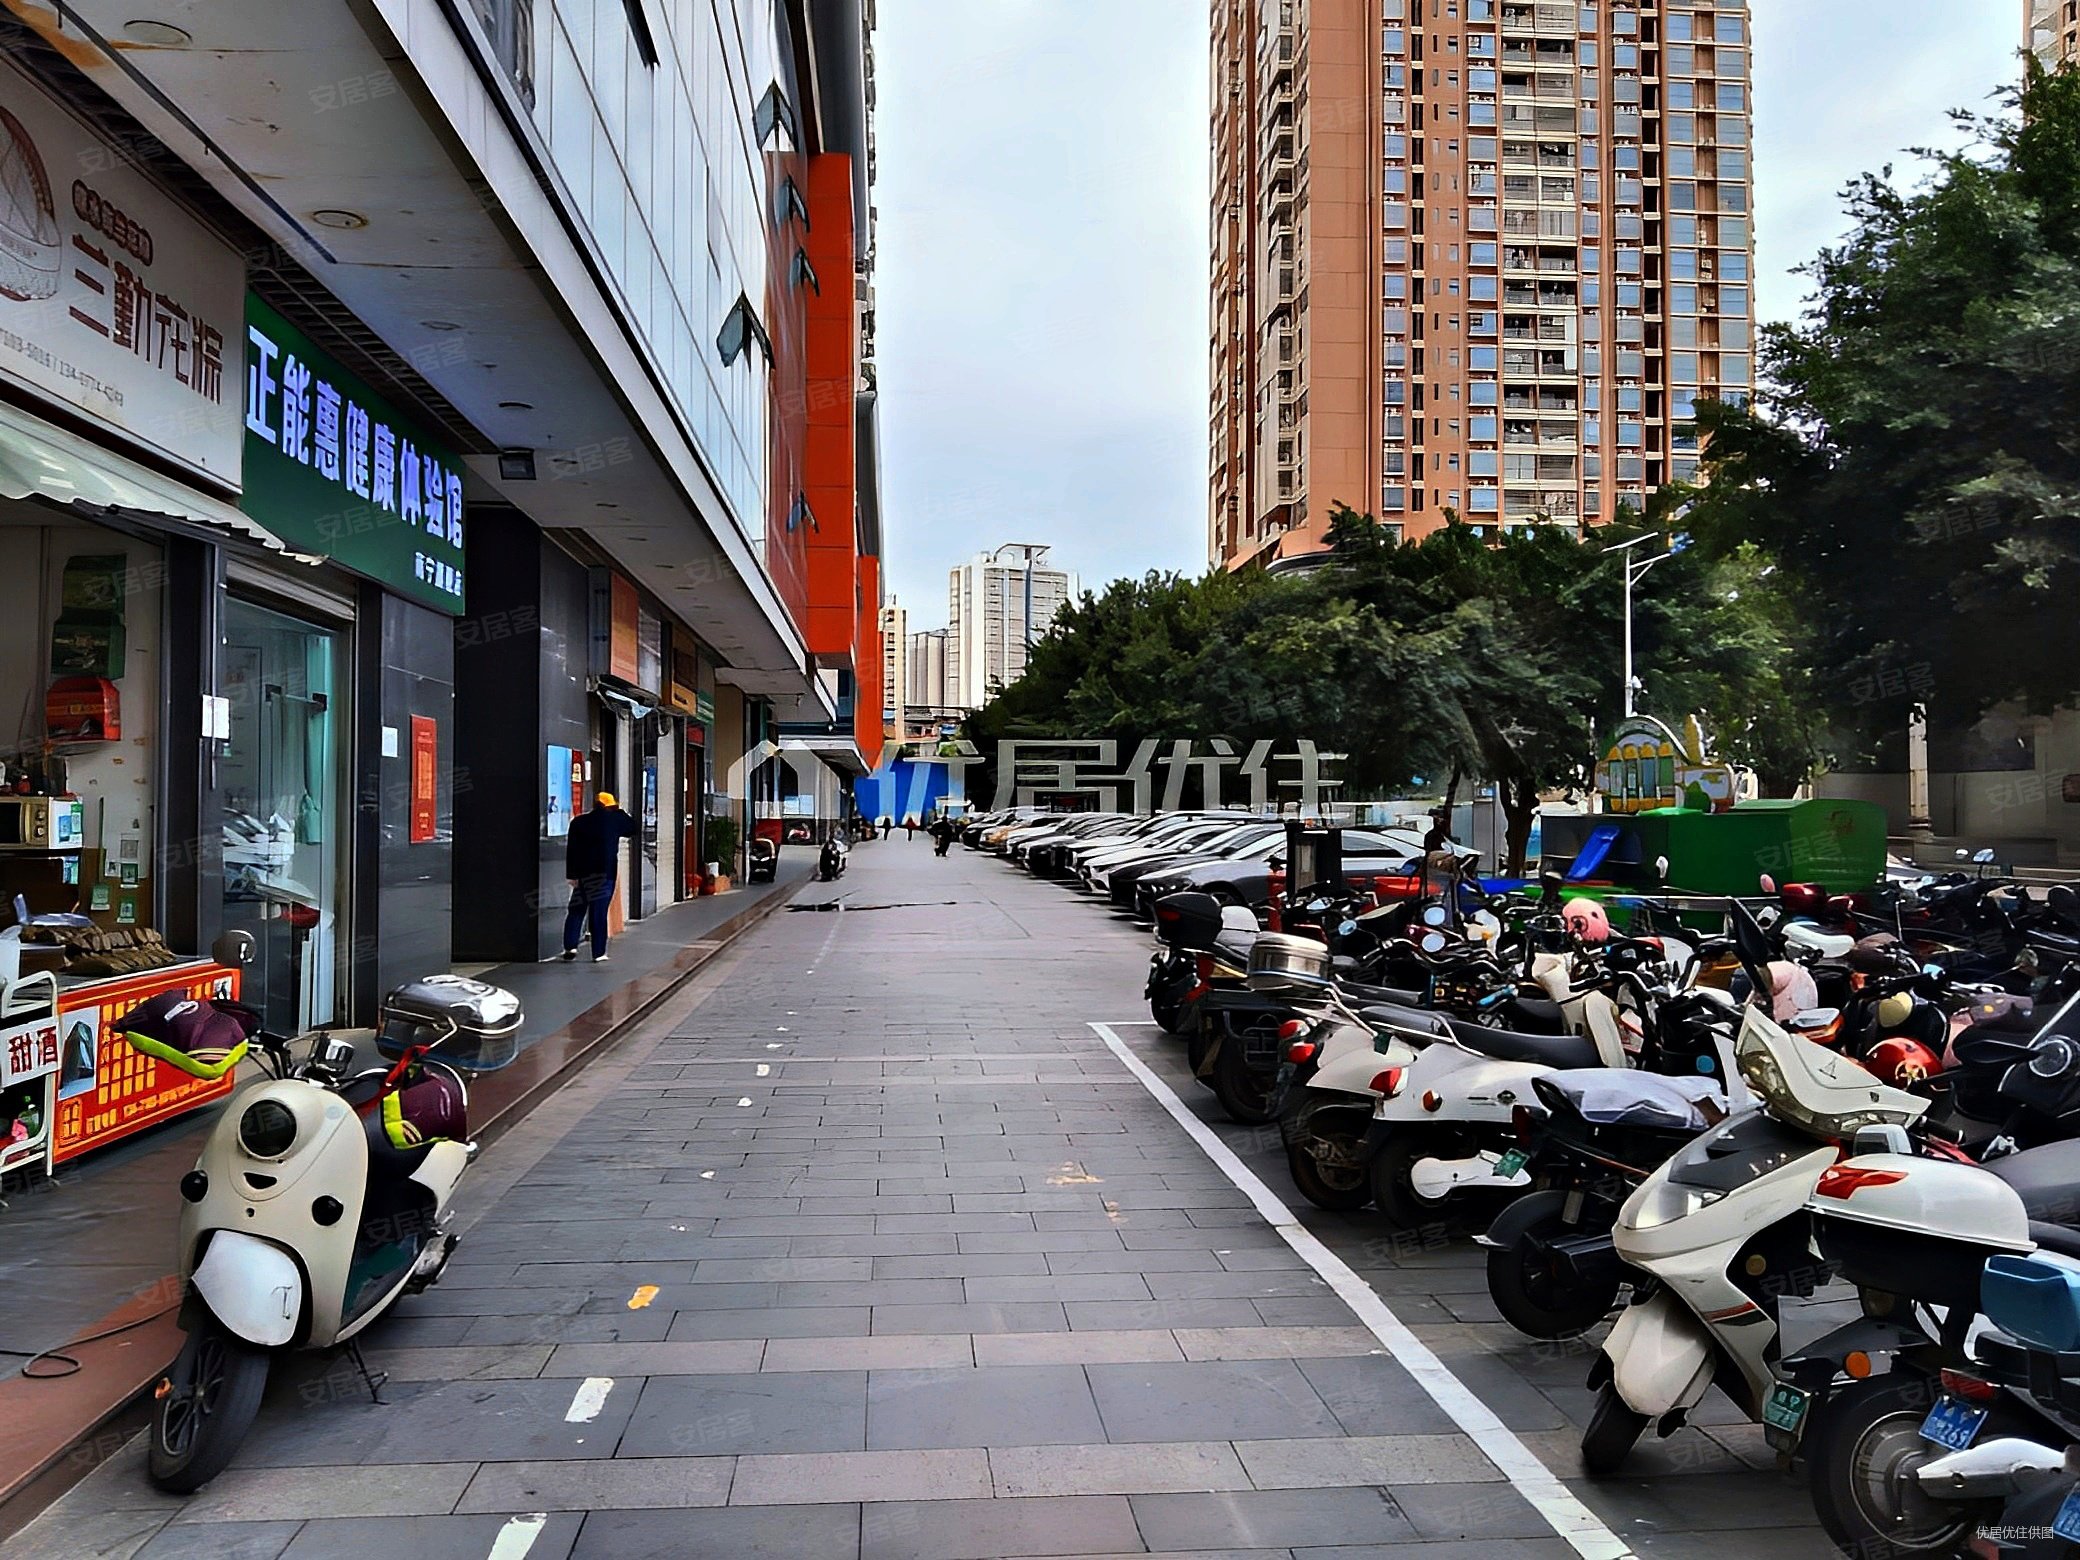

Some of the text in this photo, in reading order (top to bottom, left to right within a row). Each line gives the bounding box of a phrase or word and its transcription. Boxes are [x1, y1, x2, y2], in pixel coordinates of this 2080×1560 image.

[246, 325, 463, 549] 正能惠健康体验馆
[8, 1026, 57, 1075] 甜酒
